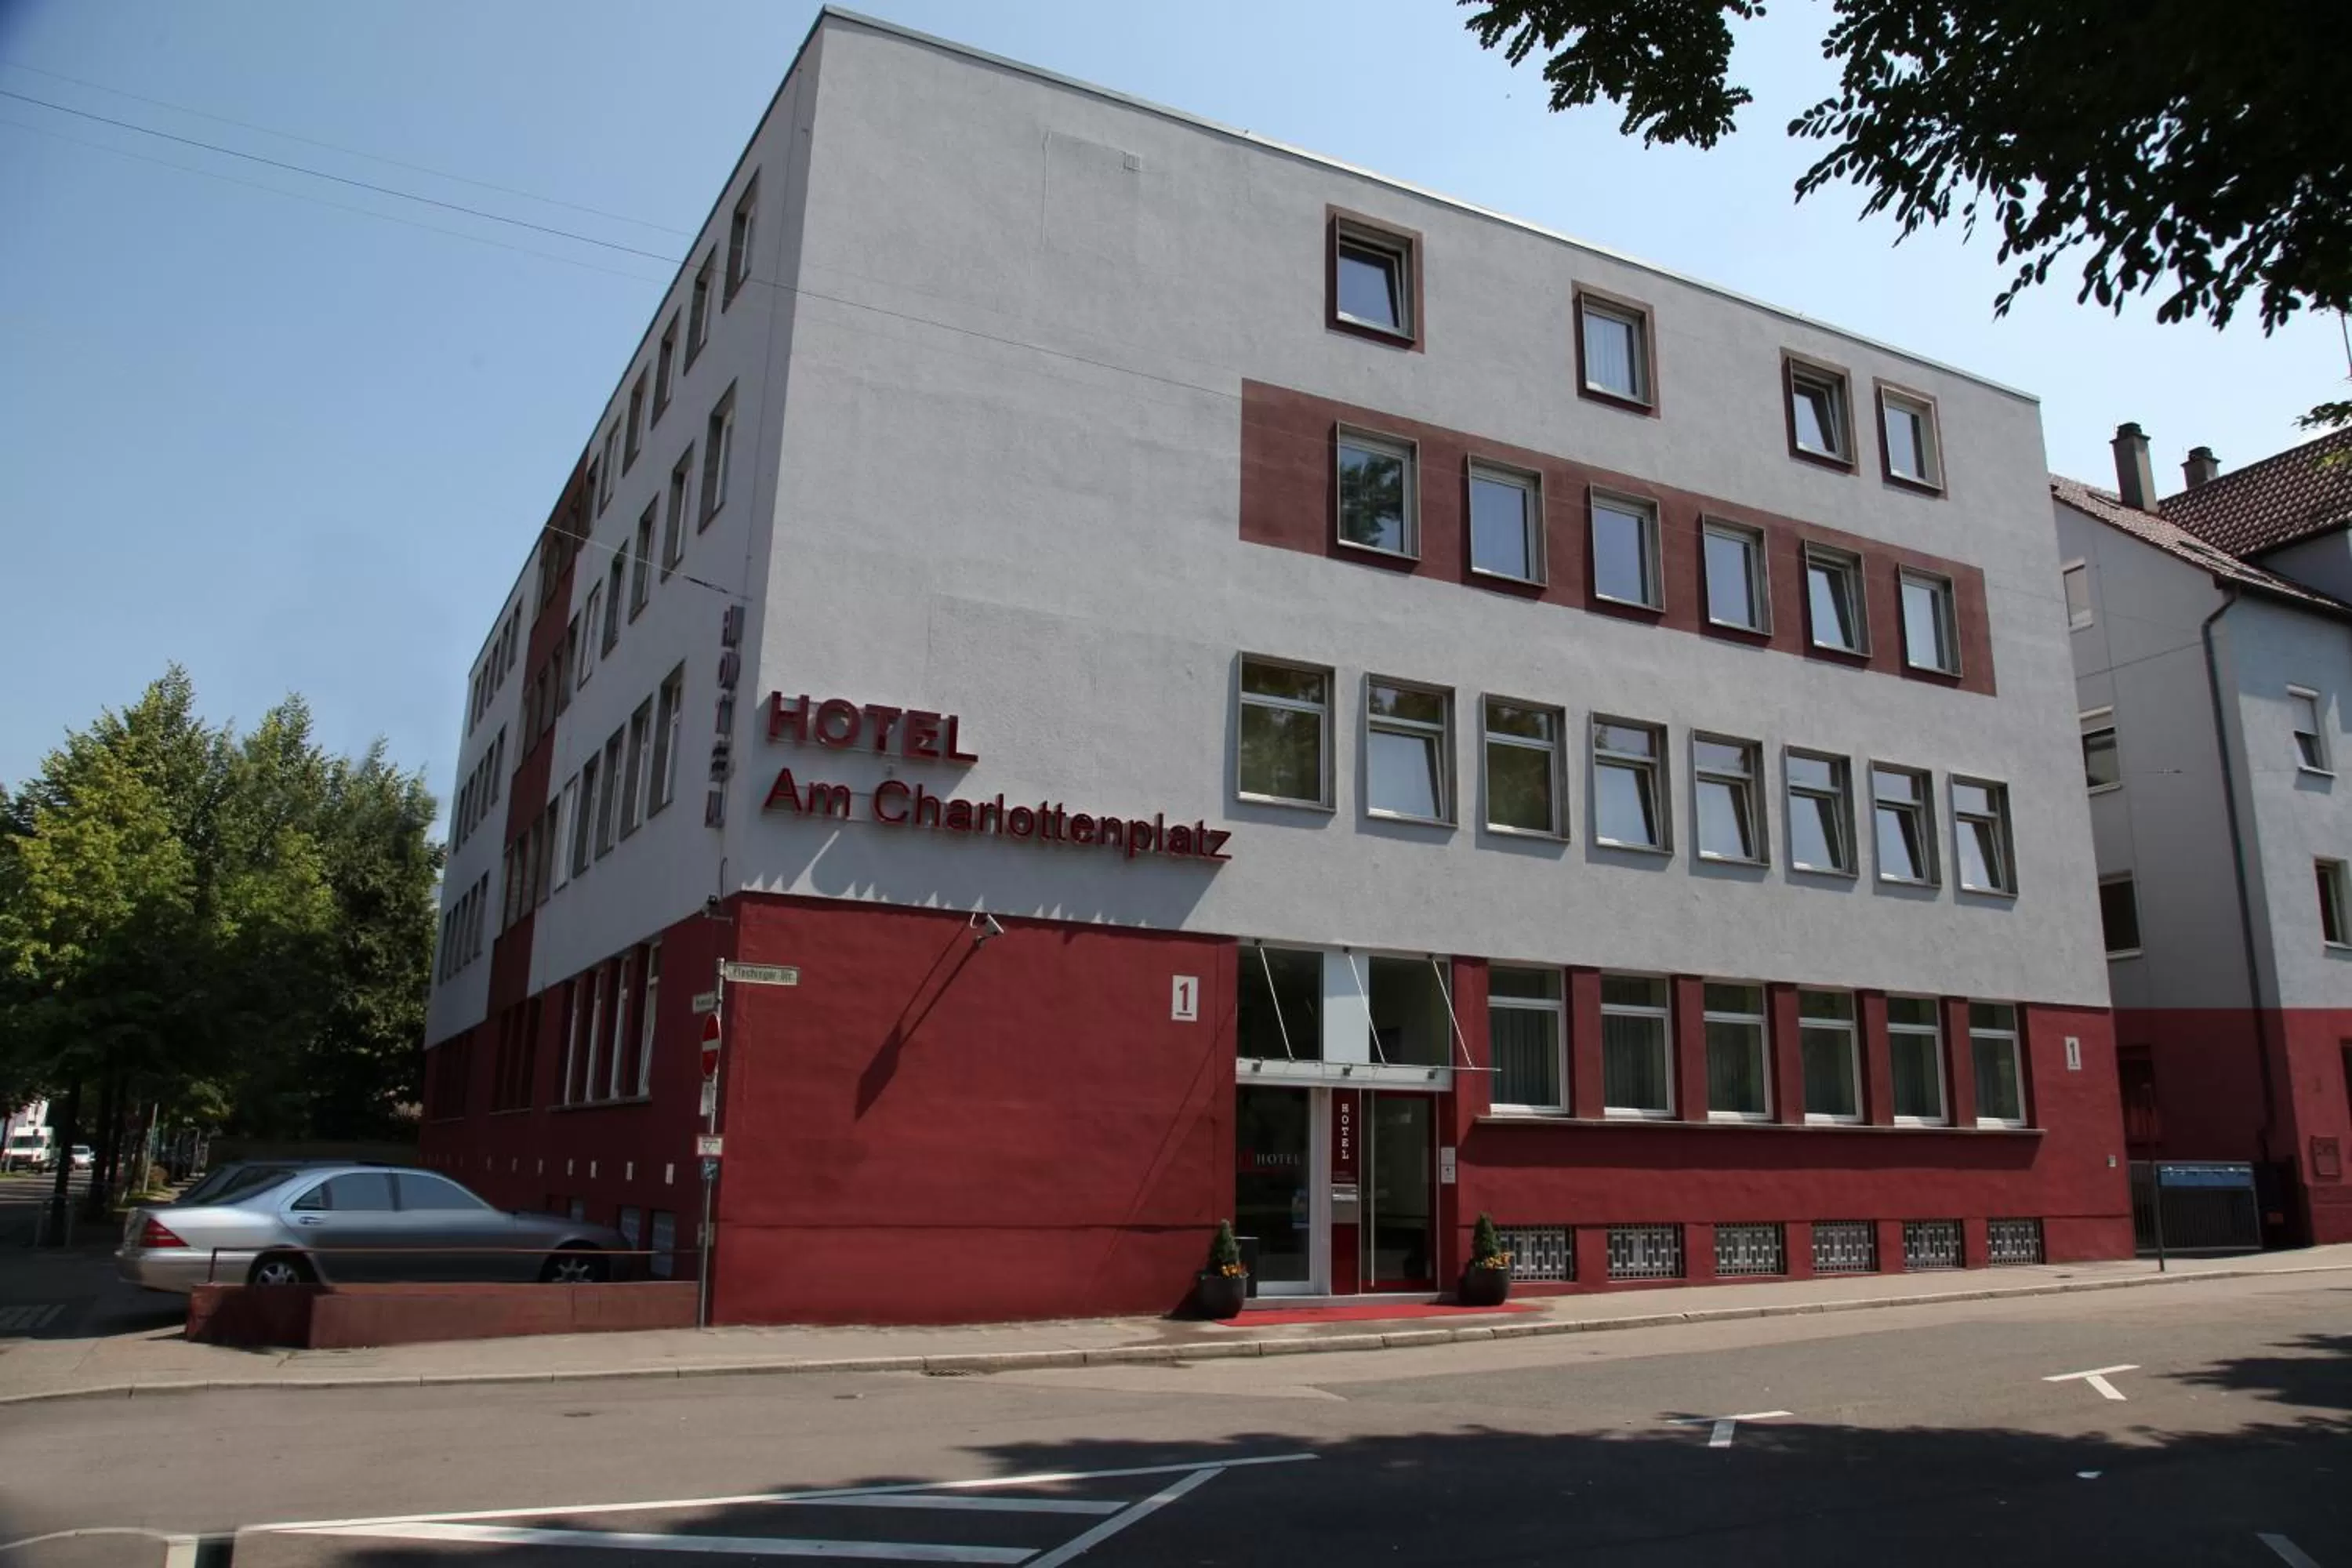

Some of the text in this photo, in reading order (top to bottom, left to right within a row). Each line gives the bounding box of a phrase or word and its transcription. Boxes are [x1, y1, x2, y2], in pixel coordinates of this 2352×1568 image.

[767, 690, 979, 764] HOTEL
[763, 767, 1233, 862] Am Charlottenplatz
[1178, 981, 1191, 1014] 1
[2069, 1042, 2077, 1066] 1
[1341, 1102, 1350, 1160] HOTEL
[1256, 1152, 1302, 1166] HOTEL
